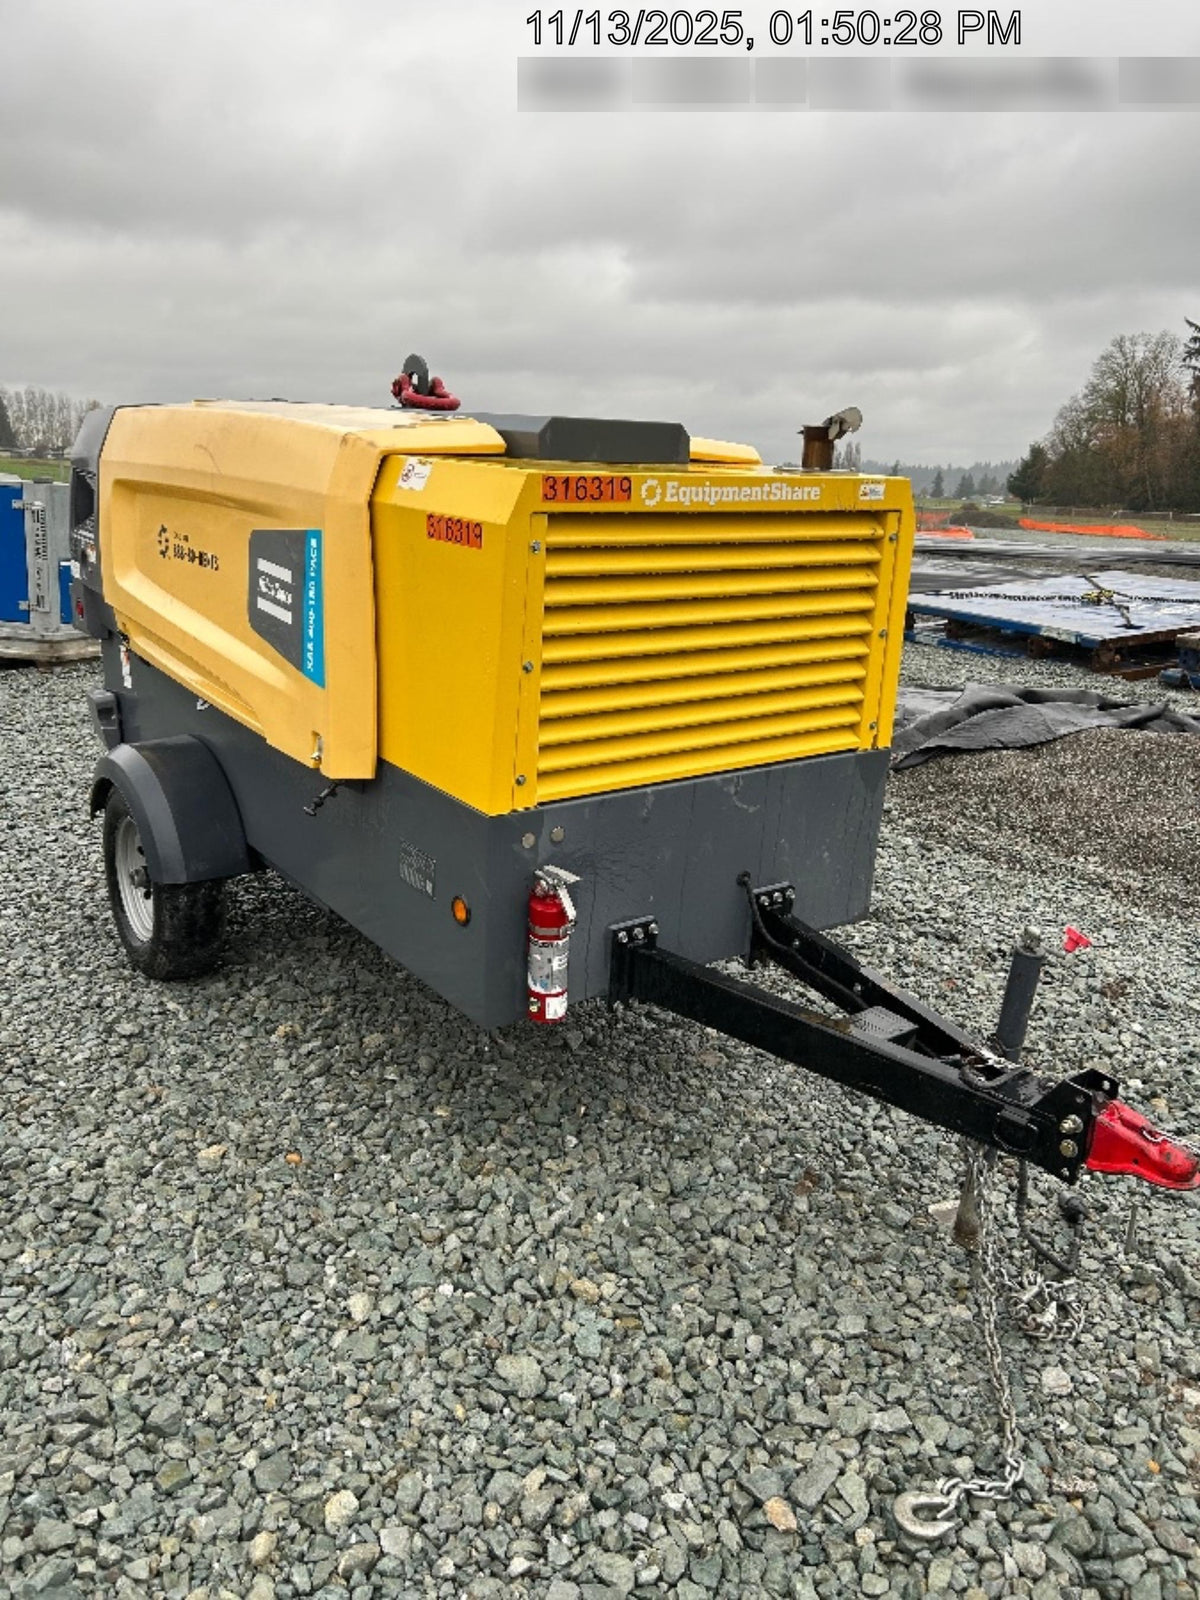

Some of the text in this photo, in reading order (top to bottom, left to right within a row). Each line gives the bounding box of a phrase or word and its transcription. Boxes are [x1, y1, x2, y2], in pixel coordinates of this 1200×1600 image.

[543, 475, 632, 501] 316319
[664, 481, 822, 506] EquipmentShare
[427, 513, 483, 550] 316319
